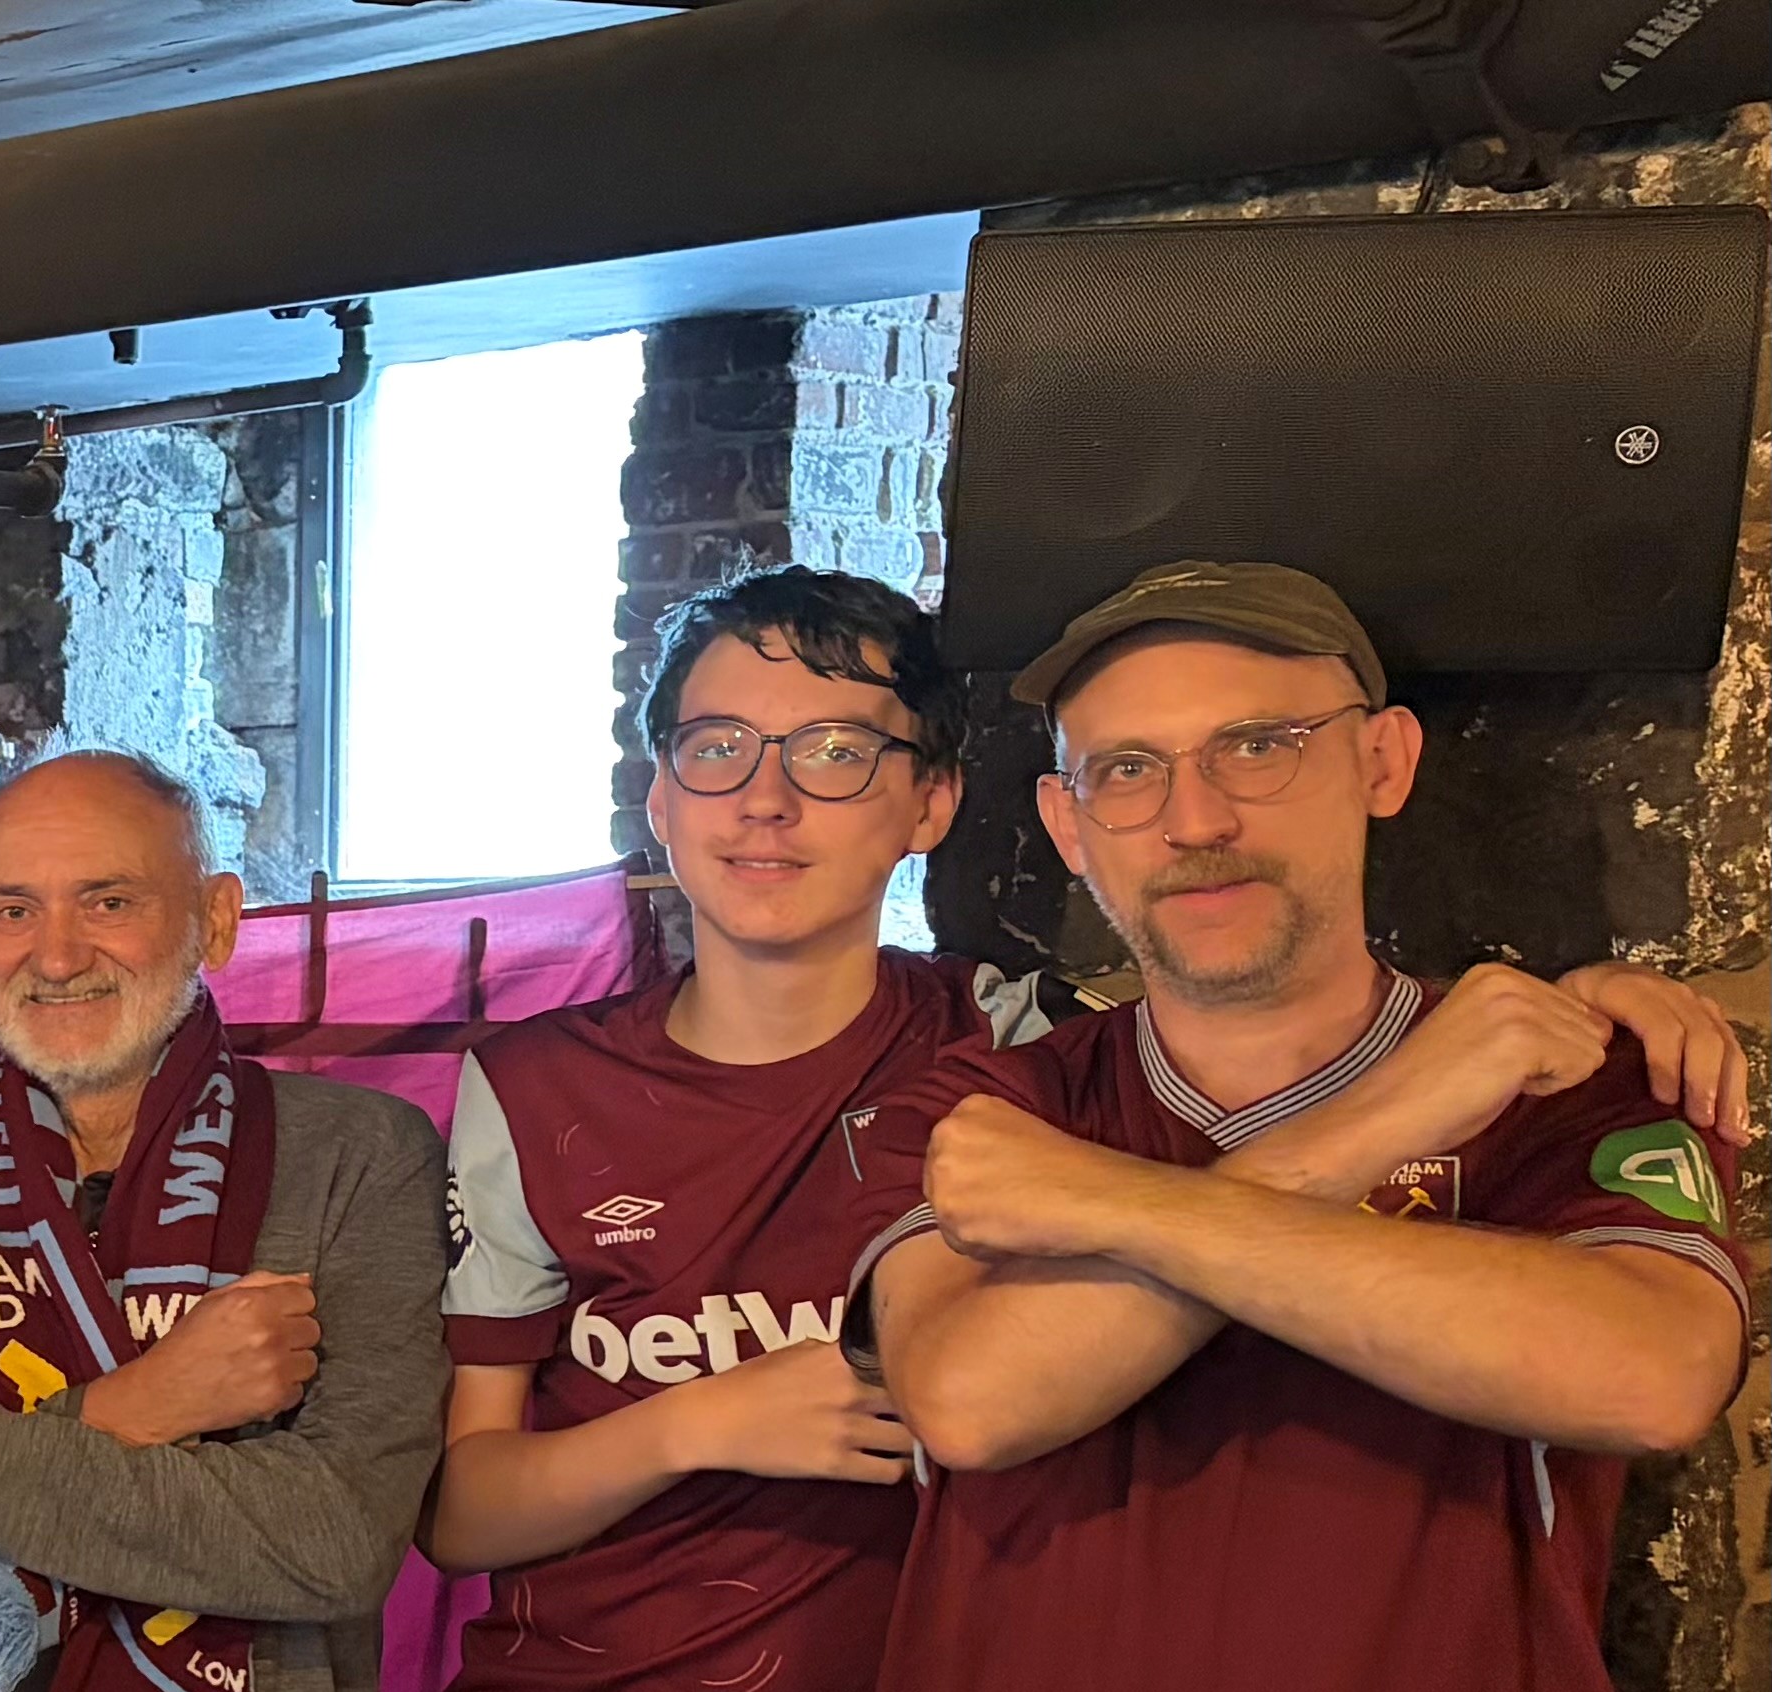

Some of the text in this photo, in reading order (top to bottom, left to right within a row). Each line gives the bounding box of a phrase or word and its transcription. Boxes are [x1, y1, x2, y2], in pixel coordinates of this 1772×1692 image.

[158, 1052, 236, 1225] WES
[594, 1225, 656, 1247] umbro
[570, 1290, 846, 1385] betw
